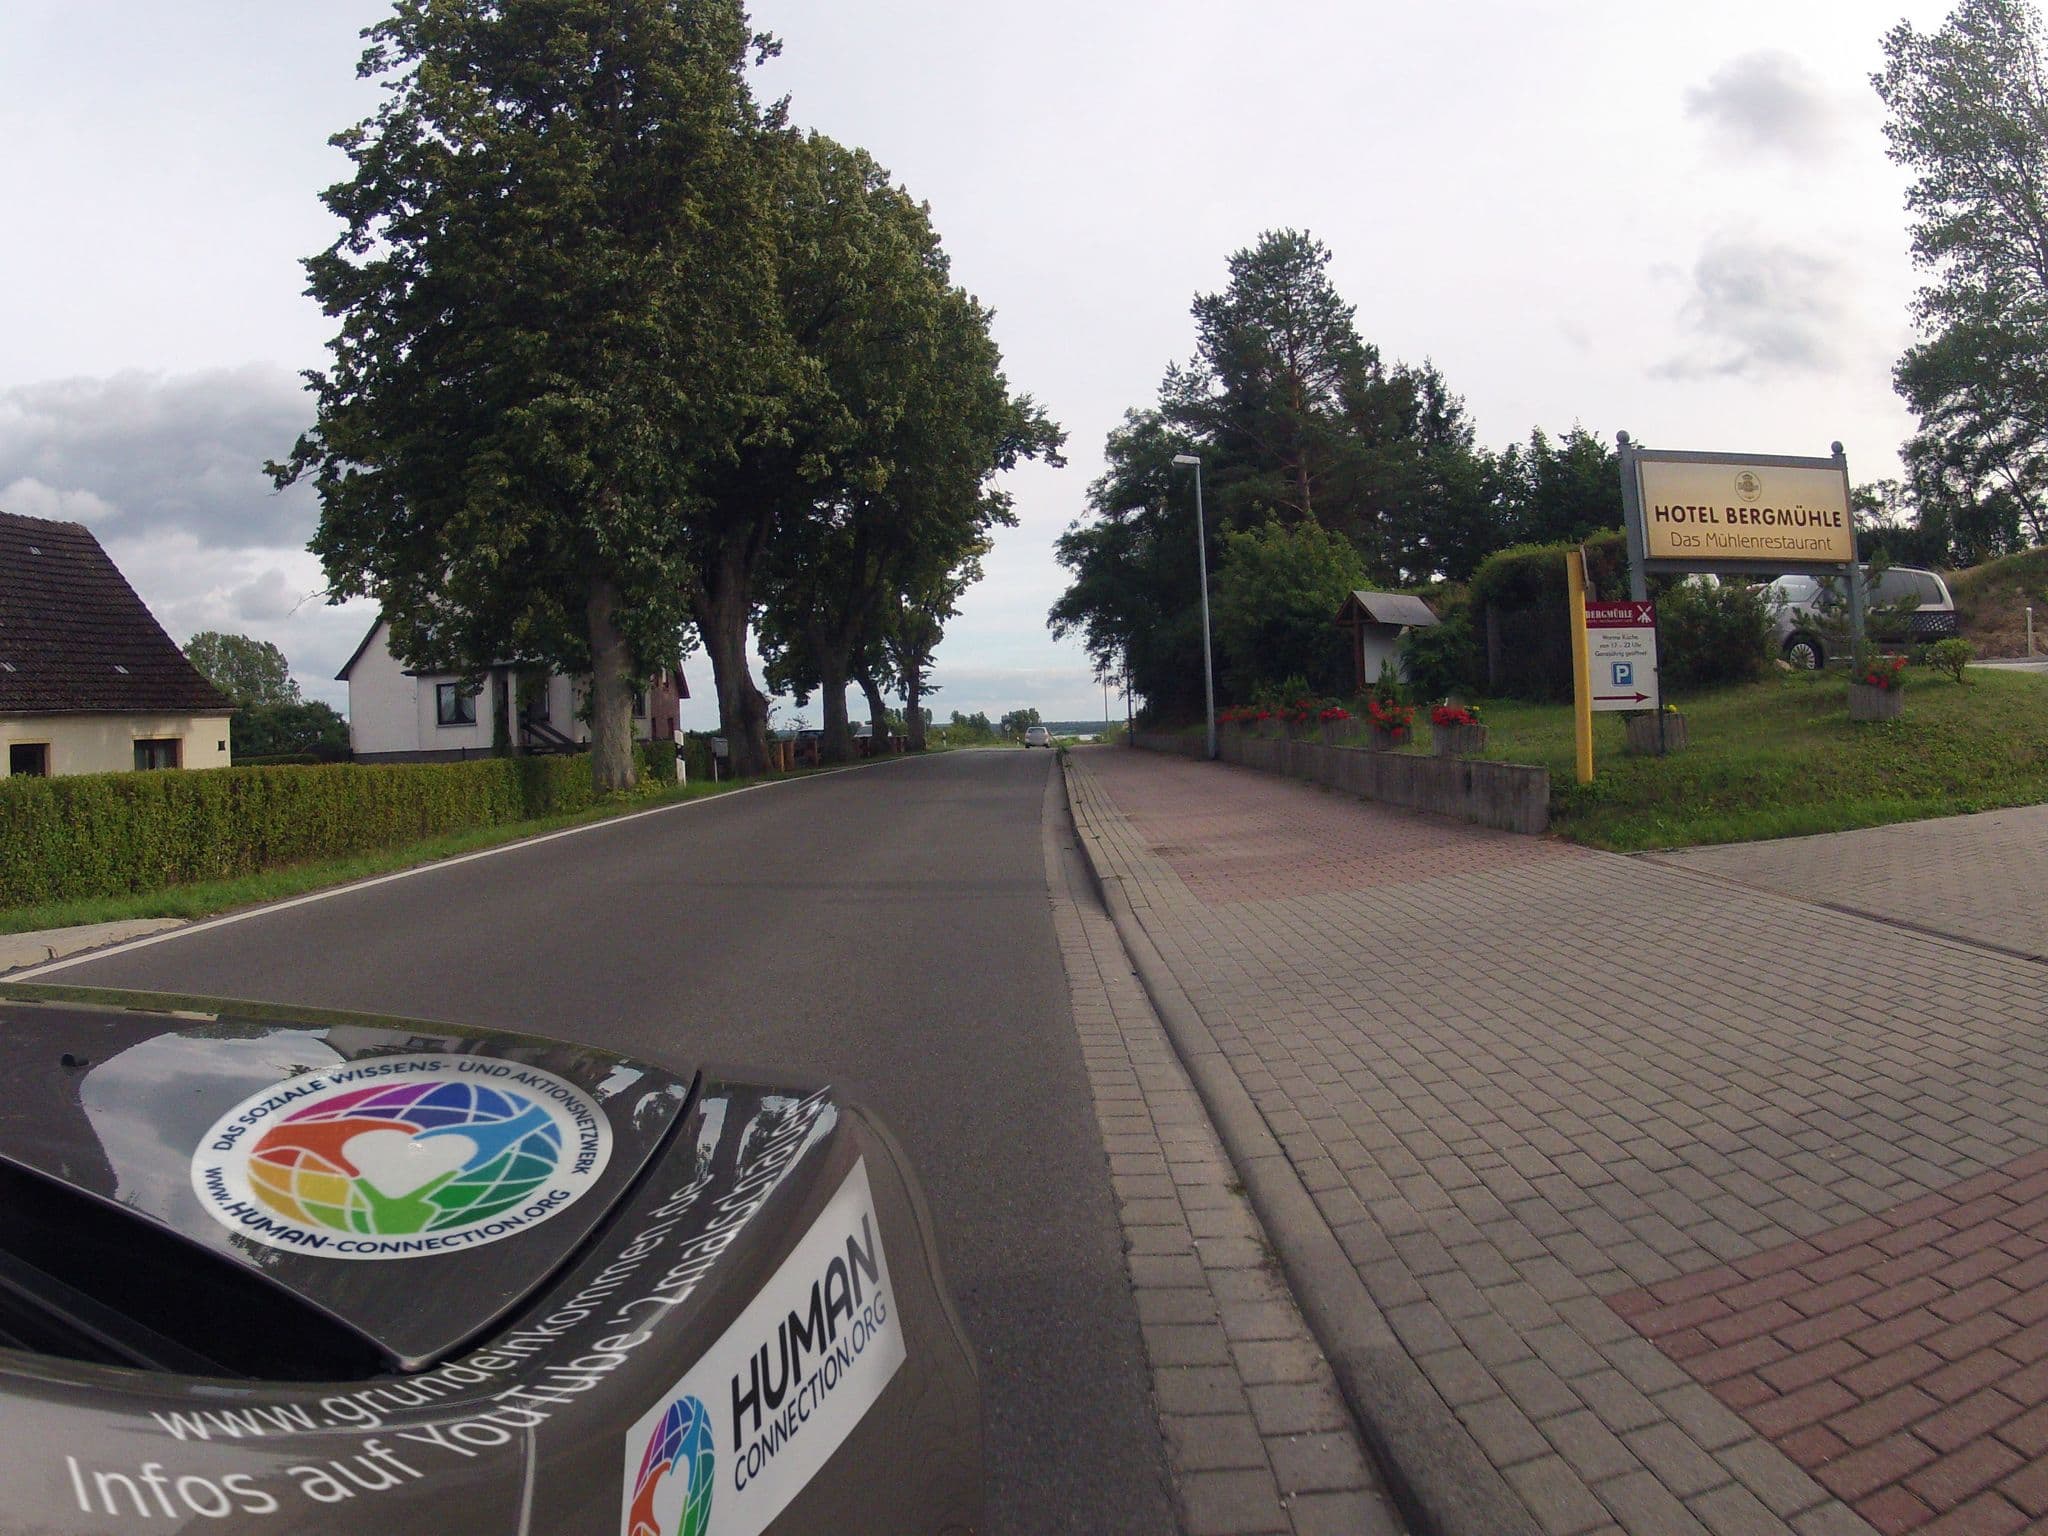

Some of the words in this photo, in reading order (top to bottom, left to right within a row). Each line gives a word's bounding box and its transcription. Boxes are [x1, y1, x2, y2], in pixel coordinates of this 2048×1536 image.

[1655, 505, 1719, 523] HOTEL
[1726, 505, 1842, 527] BERGMÜHLE
[1671, 532, 1700, 547] Das
[1706, 533, 1833, 551] Mühlenrestaurant
[1616, 665, 1629, 683] P
[212, 1125, 246, 1151] DAS
[239, 1079, 326, 1125] SOZIALE
[330, 1060, 450, 1085] WISSENS-
[458, 1060, 511, 1078] UND
[509, 1071, 600, 1176] AKTIONSNETZWERK
[731, 1212, 880, 1454] HUMAN
[734, 1290, 887, 1492] CONNECTION.ORG
[66, 1455, 279, 1519] Infos
[286, 1439, 423, 1504] auf
[398, 1330, 653, 1458] YouTube
